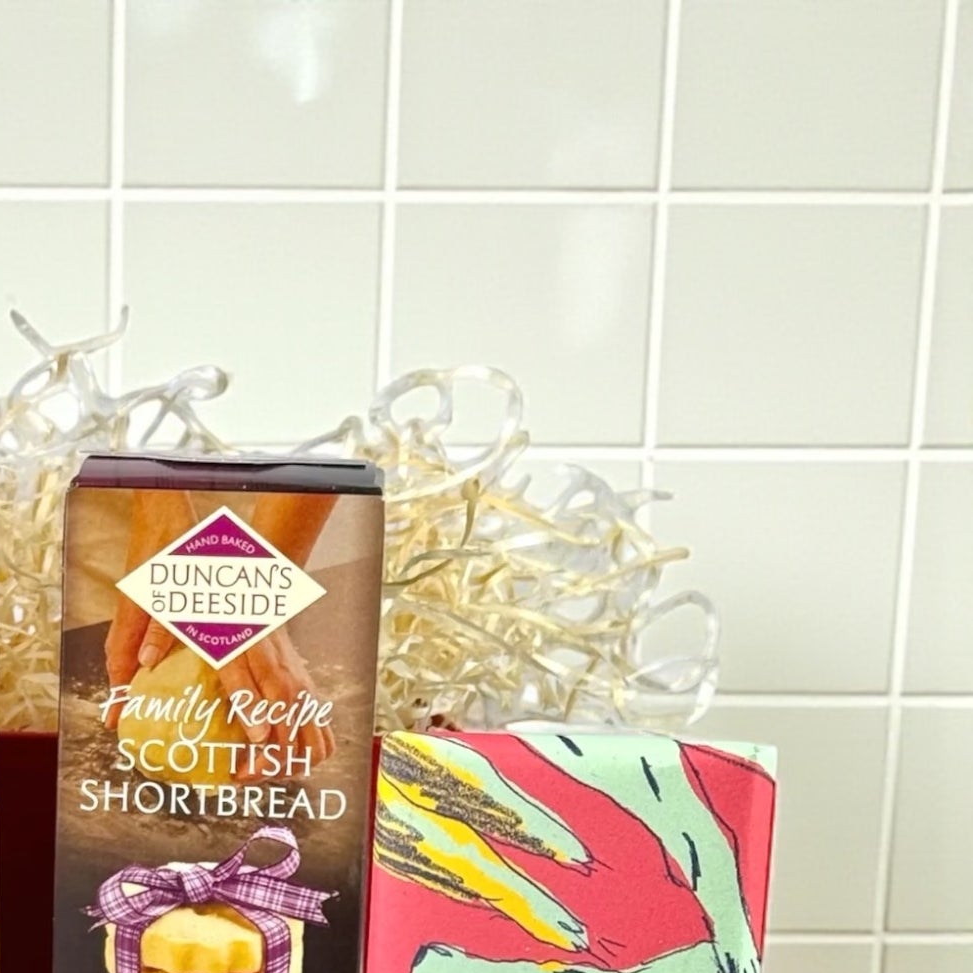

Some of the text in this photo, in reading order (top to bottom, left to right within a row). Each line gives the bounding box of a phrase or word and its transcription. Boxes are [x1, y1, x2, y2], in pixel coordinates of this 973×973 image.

[185, 534, 256, 554] HAND BAKED
[150, 563, 293, 590] DUNCAN'S
[152, 589, 287, 617] OF DEESIDE
[186, 624, 253, 646] IN SCOTLAND
[99, 684, 333, 744] Family Recipe
[116, 738, 312, 777] SCOTTISH
[79, 780, 347, 820] SHORTBREAD
